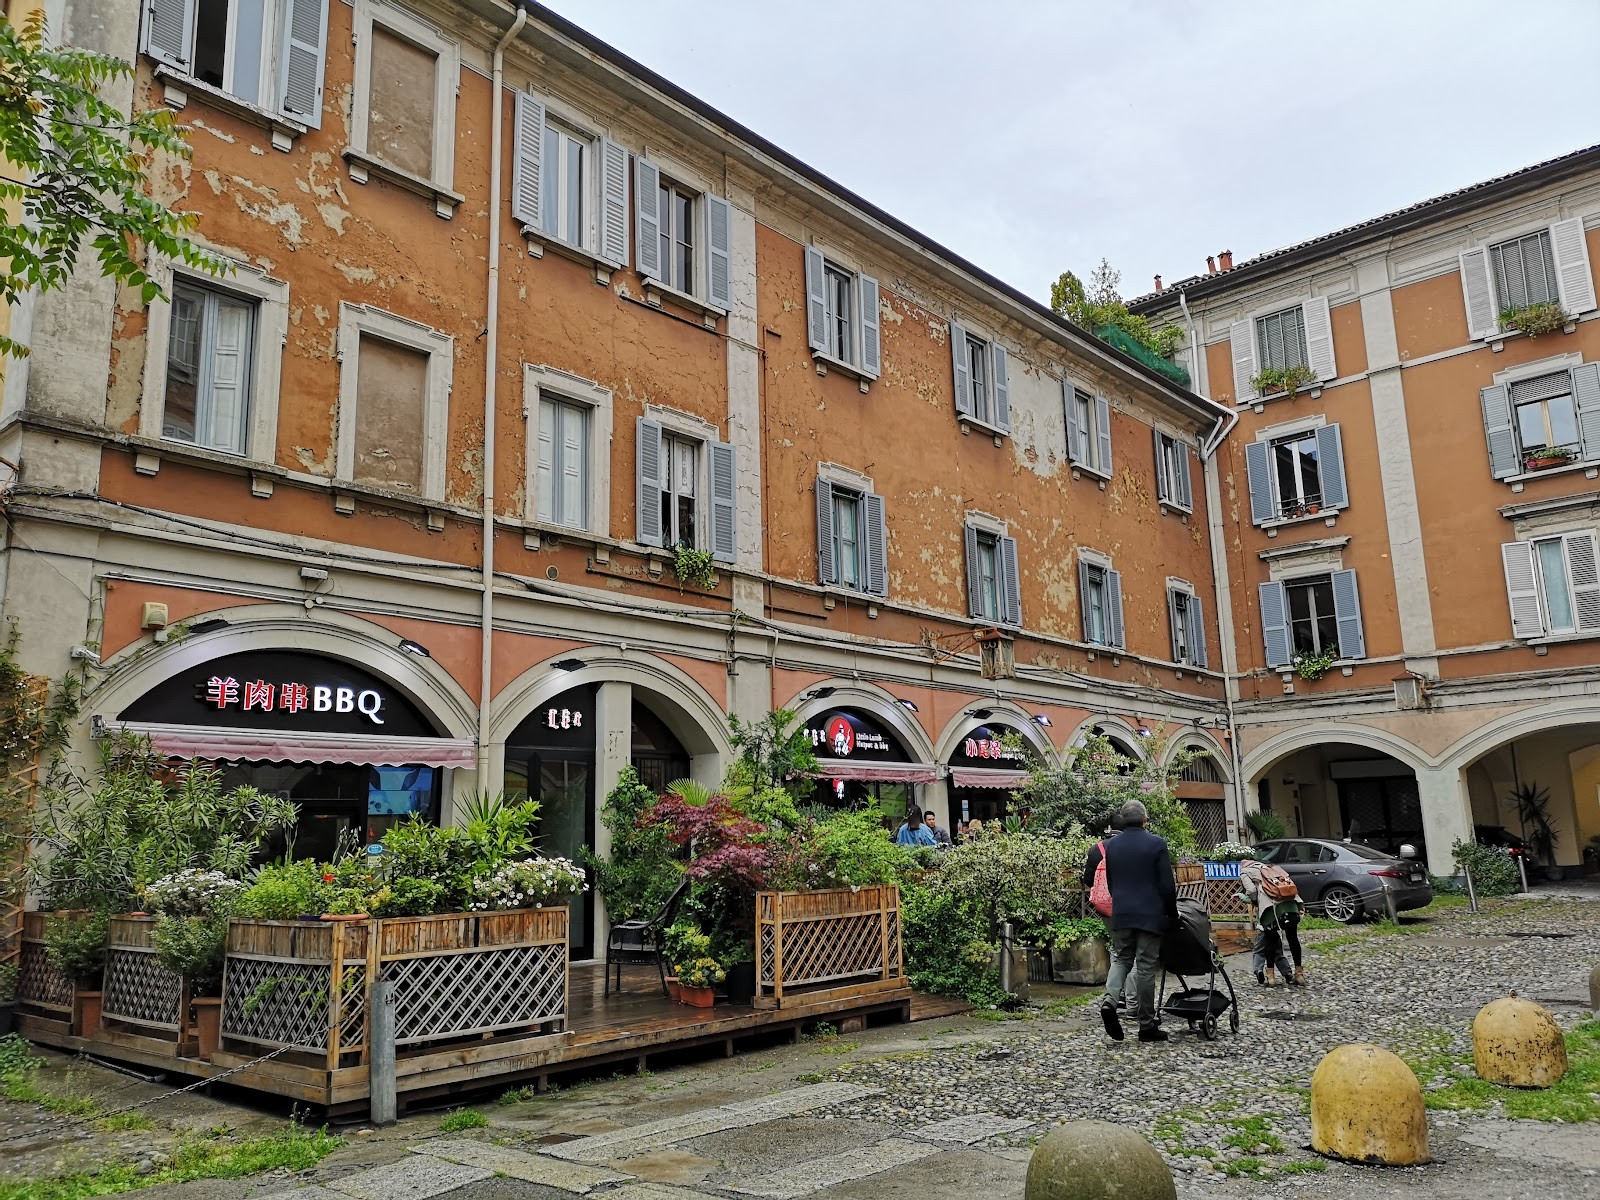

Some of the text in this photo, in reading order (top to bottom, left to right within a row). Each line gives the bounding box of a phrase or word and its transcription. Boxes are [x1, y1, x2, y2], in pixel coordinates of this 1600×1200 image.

[206, 676, 385, 724] 羊肉串 BBQ
